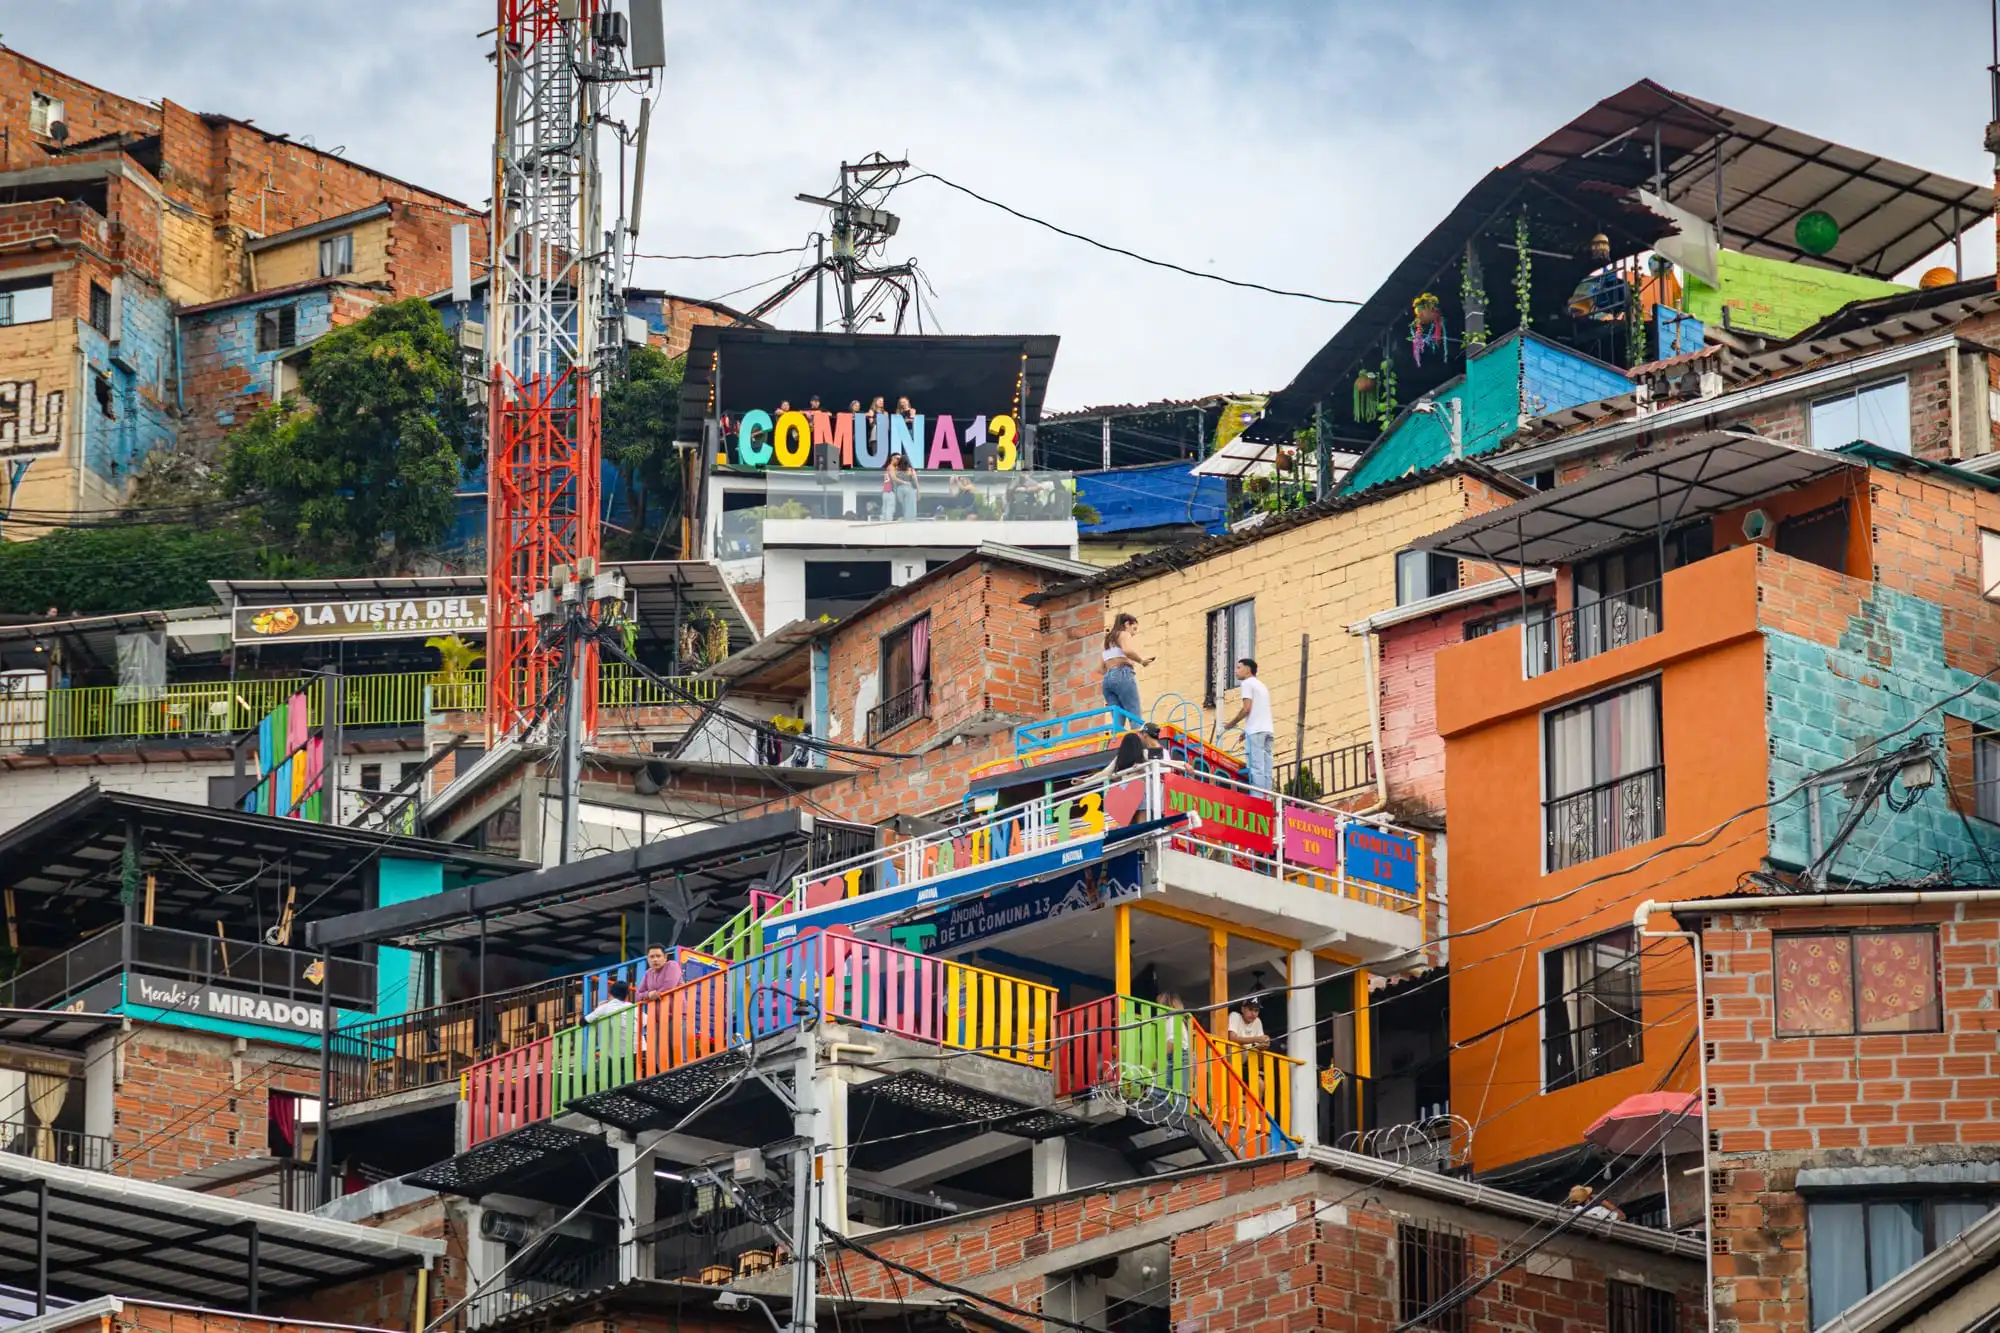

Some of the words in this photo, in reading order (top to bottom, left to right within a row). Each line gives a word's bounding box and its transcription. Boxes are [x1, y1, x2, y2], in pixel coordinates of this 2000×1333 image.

[304, 605, 336, 626] LA
[342, 600, 419, 624] VISTA
[425, 597, 474, 619] DEL
[386, 614, 489, 632] RESTAURAN
[1054, 792, 1105, 844] 13
[1168, 789, 1272, 837] MEDELLIN
[1288, 816, 1334, 840] WELCOME
[1302, 838, 1321, 856] TO
[1350, 831, 1413, 864] COMUNA
[1373, 858, 1393, 880] 13
[939, 926, 957, 946] DE
[960, 921, 976, 938] LA
[979, 904, 1031, 933] COMUNA
[1034, 896, 1051, 915] 13
[950, 902, 986, 926] ANDINA
[208, 991, 324, 1030] MIRADOR
